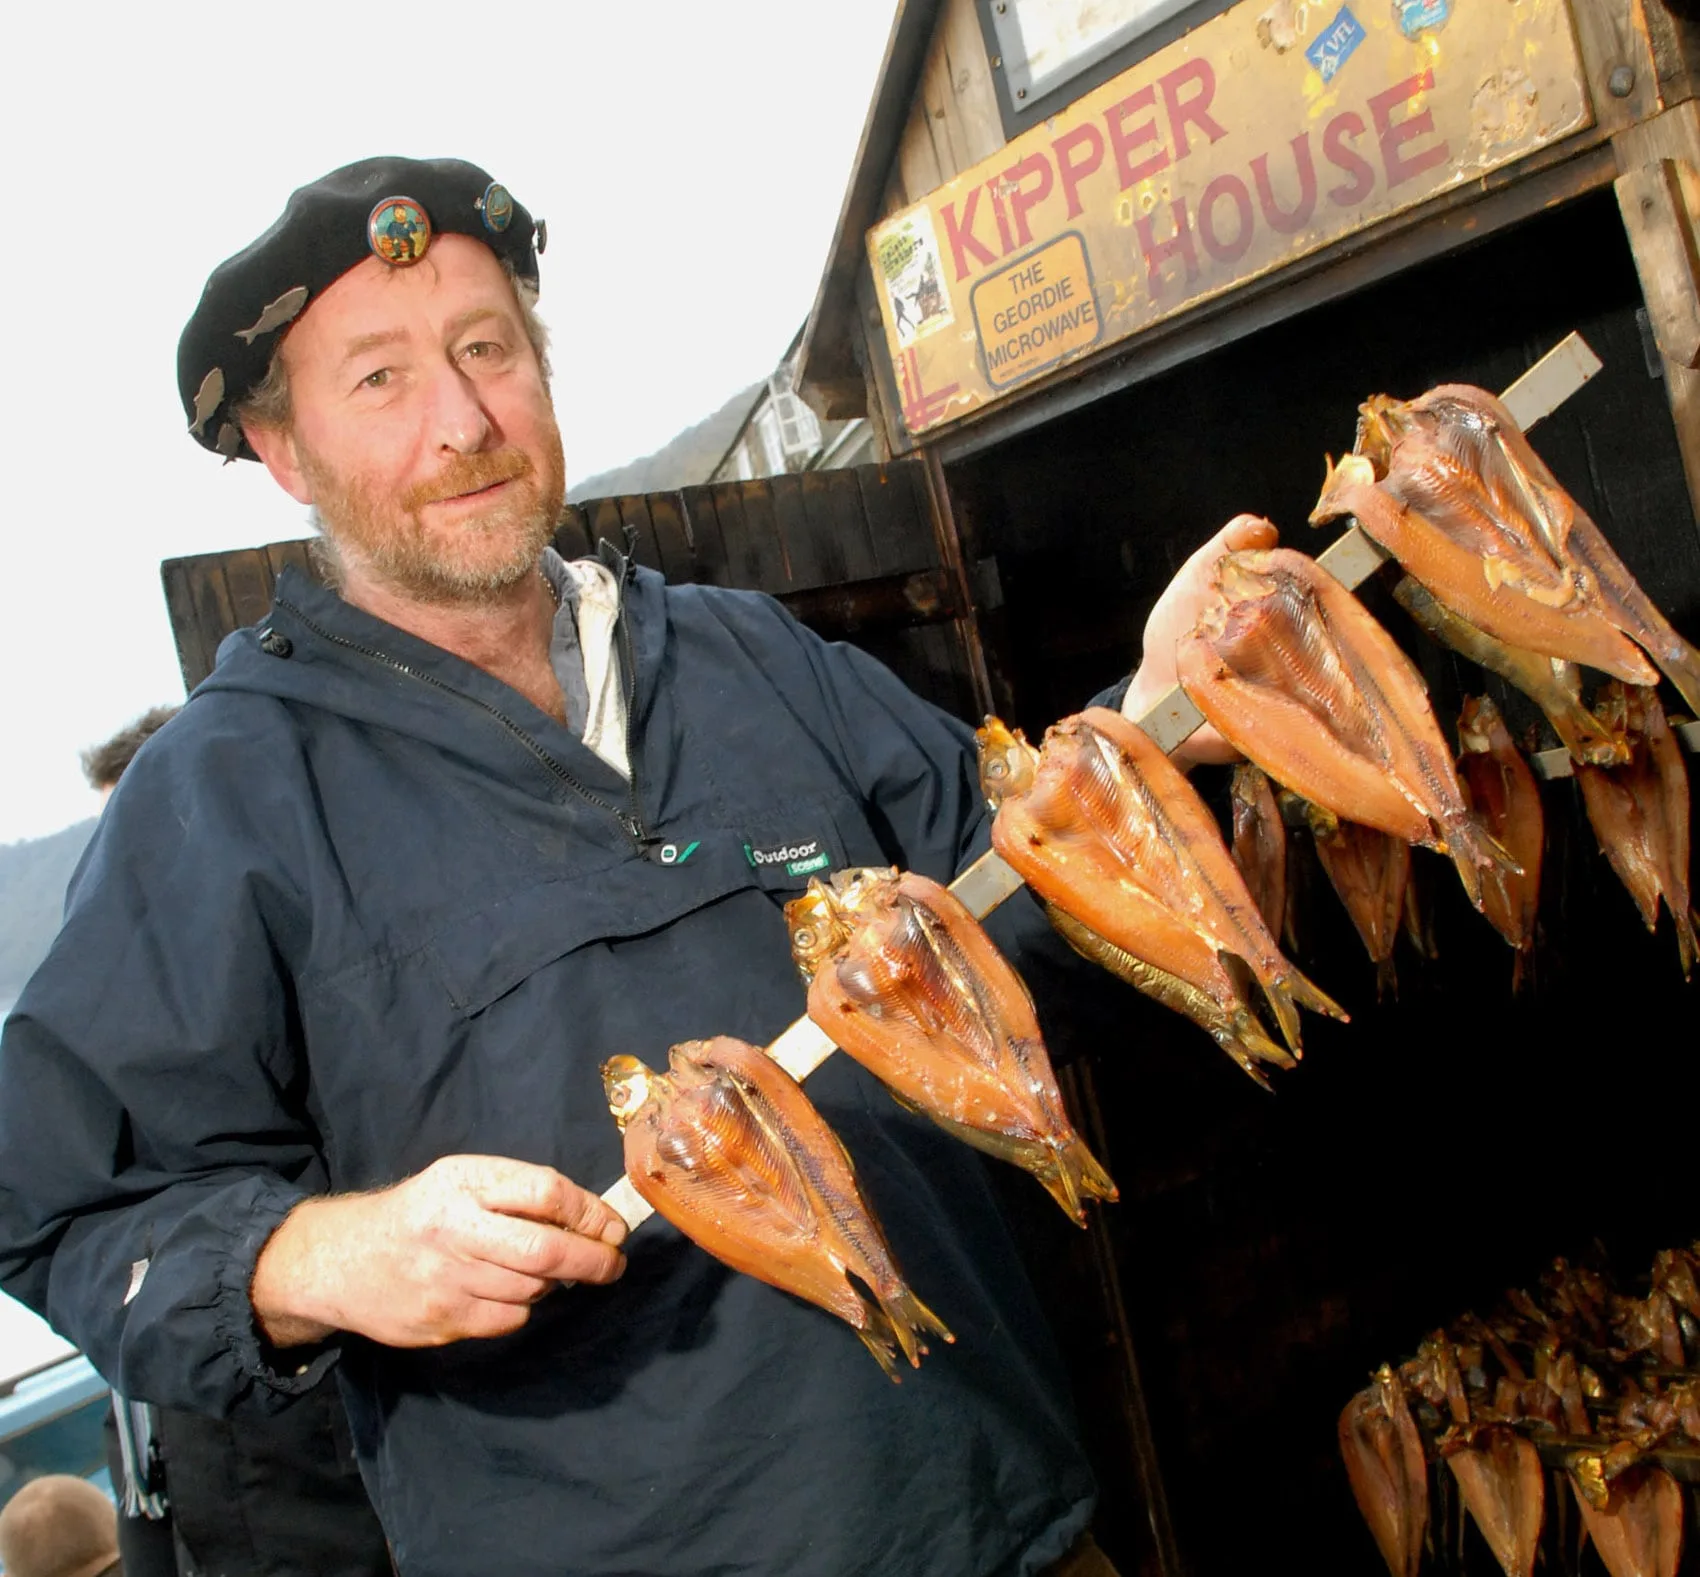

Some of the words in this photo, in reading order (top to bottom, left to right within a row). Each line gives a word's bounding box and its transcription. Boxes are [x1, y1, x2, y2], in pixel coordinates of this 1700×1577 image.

[940, 57, 1229, 283] KIPPER
[1134, 67, 1453, 300] HOUSE
[993, 276, 1074, 333] GEORDIE
[1008, 260, 1045, 294] THE
[987, 301, 1094, 369] MICROWAVE
[753, 842, 817, 864] Outdoor
